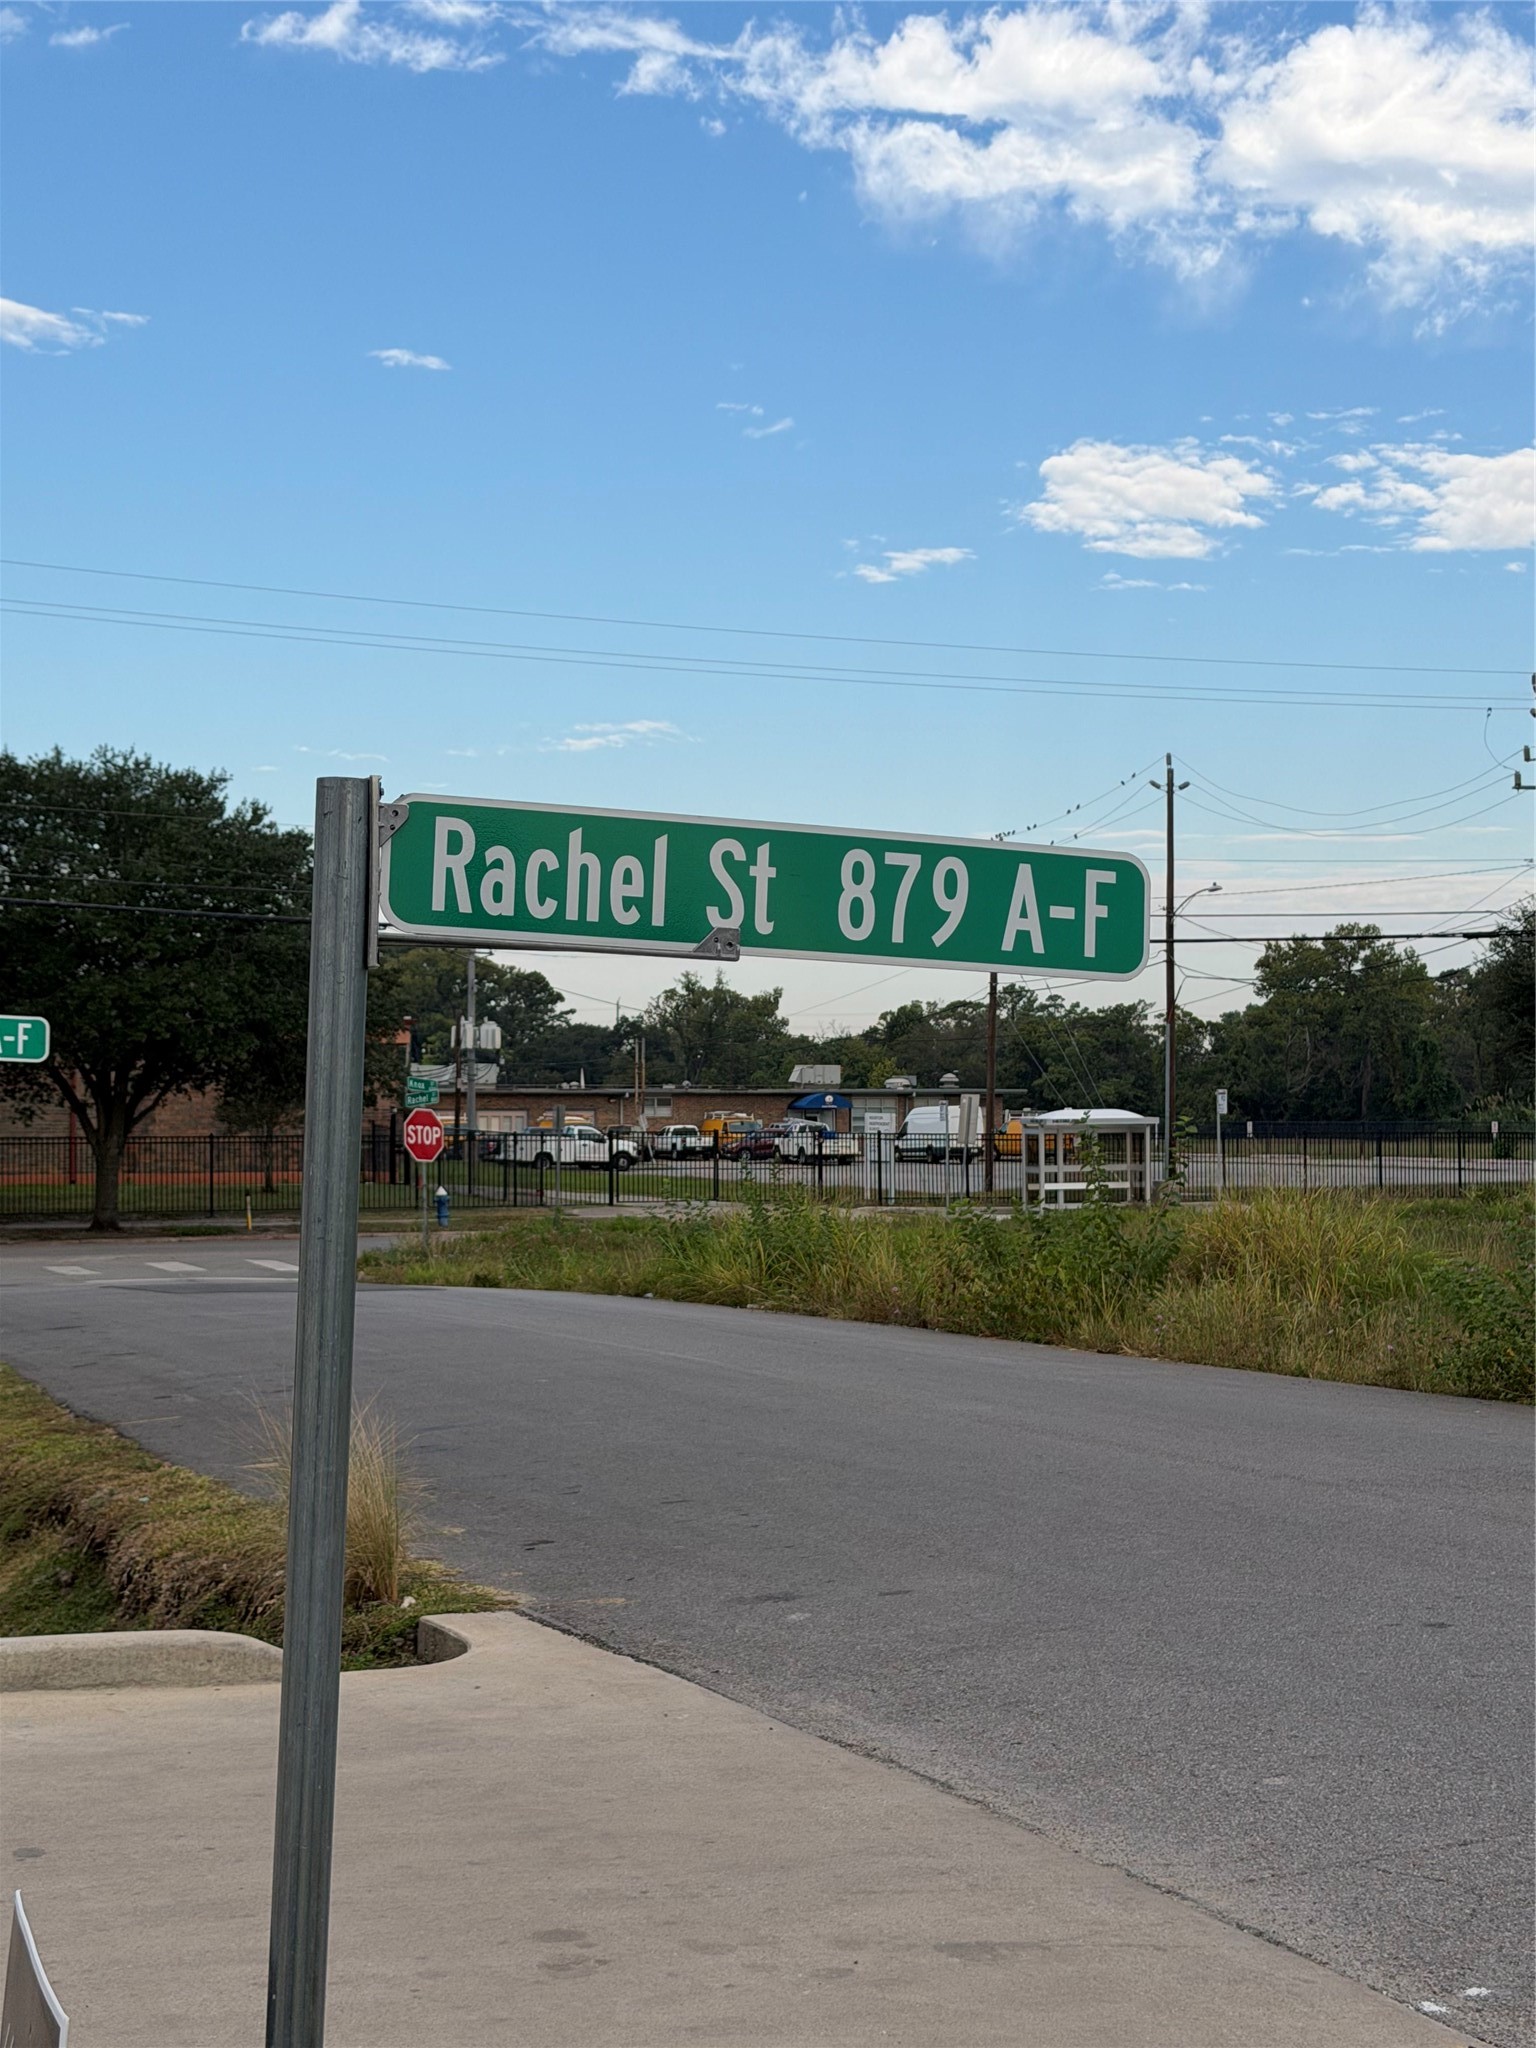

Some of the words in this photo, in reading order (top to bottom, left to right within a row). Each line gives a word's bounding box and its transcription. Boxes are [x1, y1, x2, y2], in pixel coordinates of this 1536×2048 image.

[431, 816, 669, 928] Rachel
[705, 837, 777, 936] St
[837, 848, 969, 948] 879
[1001, 863, 1117, 958] A-F
[0, 1022, 32, 1055] -F
[409, 1079, 425, 1089] Knox
[407, 1093, 429, 1105] Rachel
[407, 1125, 441, 1145] STOP
